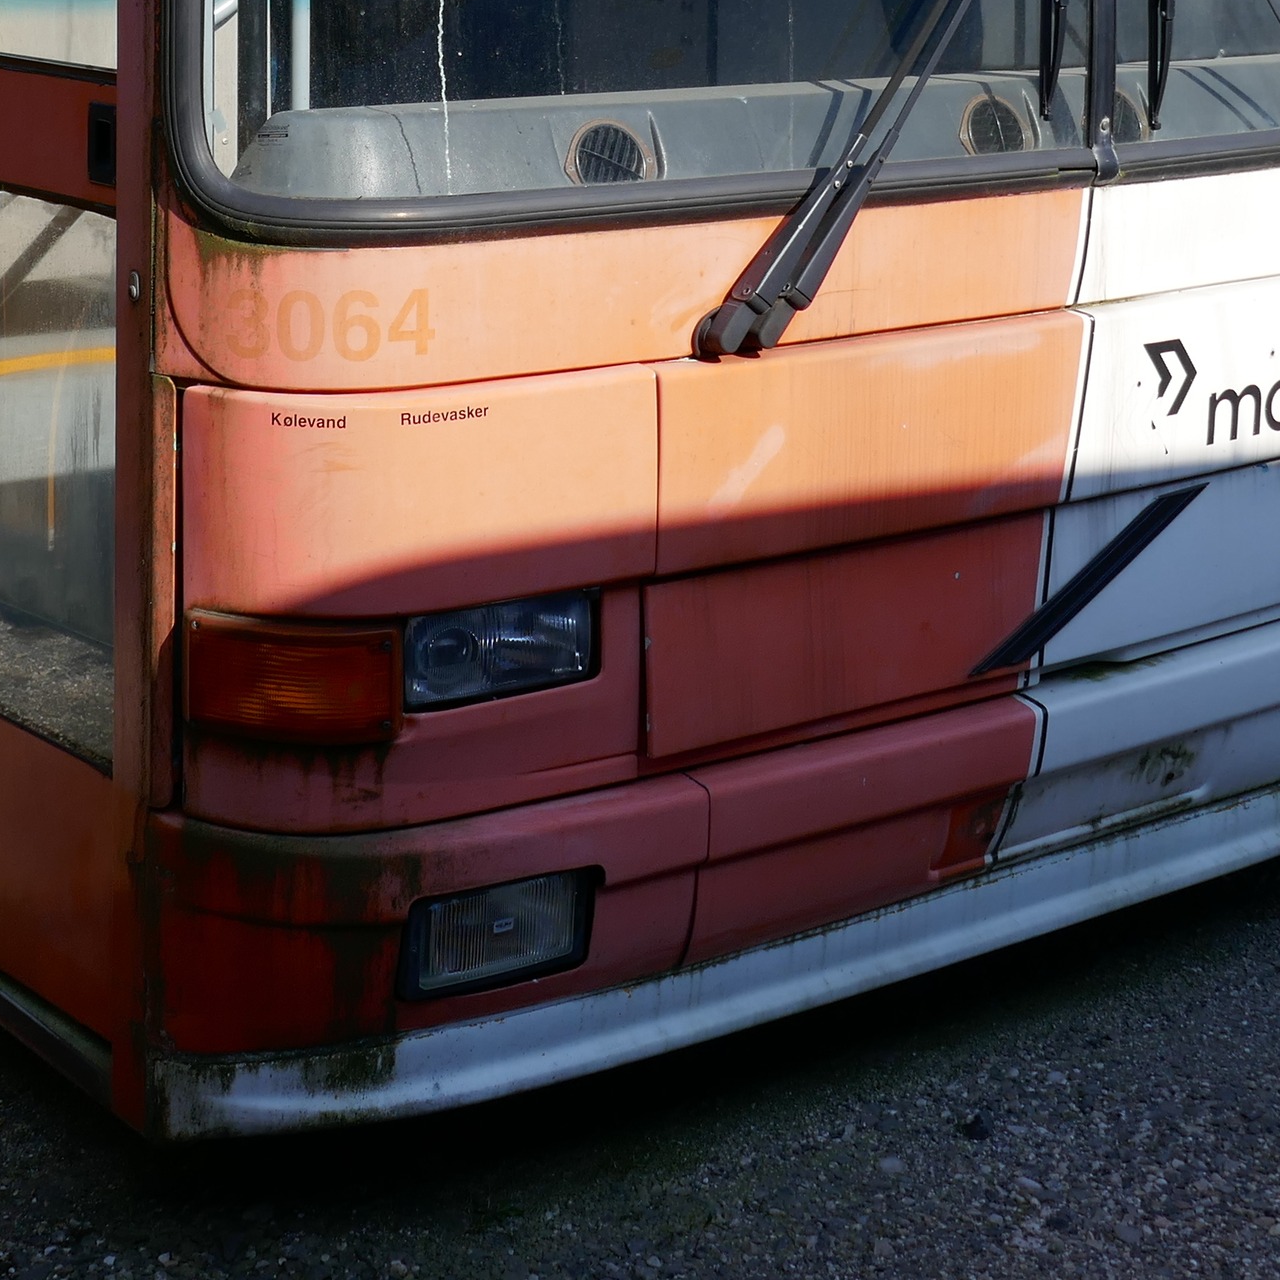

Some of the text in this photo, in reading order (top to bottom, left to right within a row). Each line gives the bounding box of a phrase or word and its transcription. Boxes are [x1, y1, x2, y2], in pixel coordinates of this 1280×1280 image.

[227, 286, 435, 362] 3064
[271, 404, 490, 430] Kølevand Rudevasker
